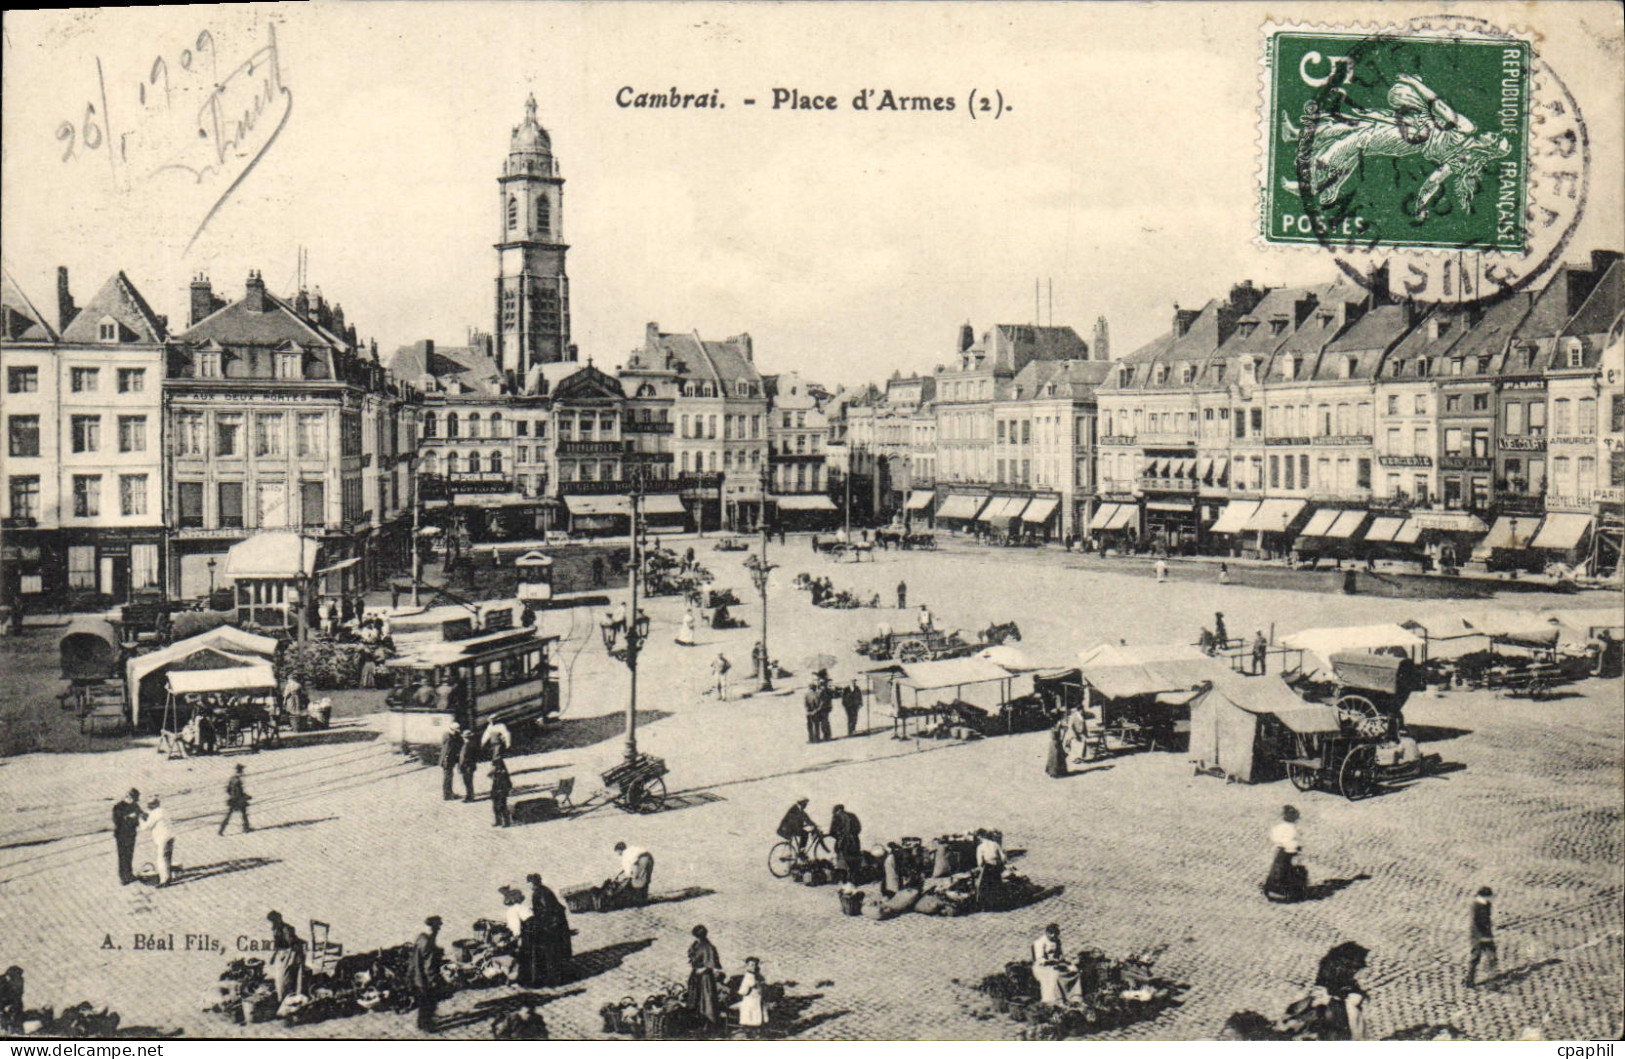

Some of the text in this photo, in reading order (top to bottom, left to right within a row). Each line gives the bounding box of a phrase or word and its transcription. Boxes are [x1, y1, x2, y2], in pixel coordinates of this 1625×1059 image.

[1300, 51, 1353, 87] 5
[1282, 213, 1365, 236] POSTES
[1550, 437, 1595, 445] ARMURIER
